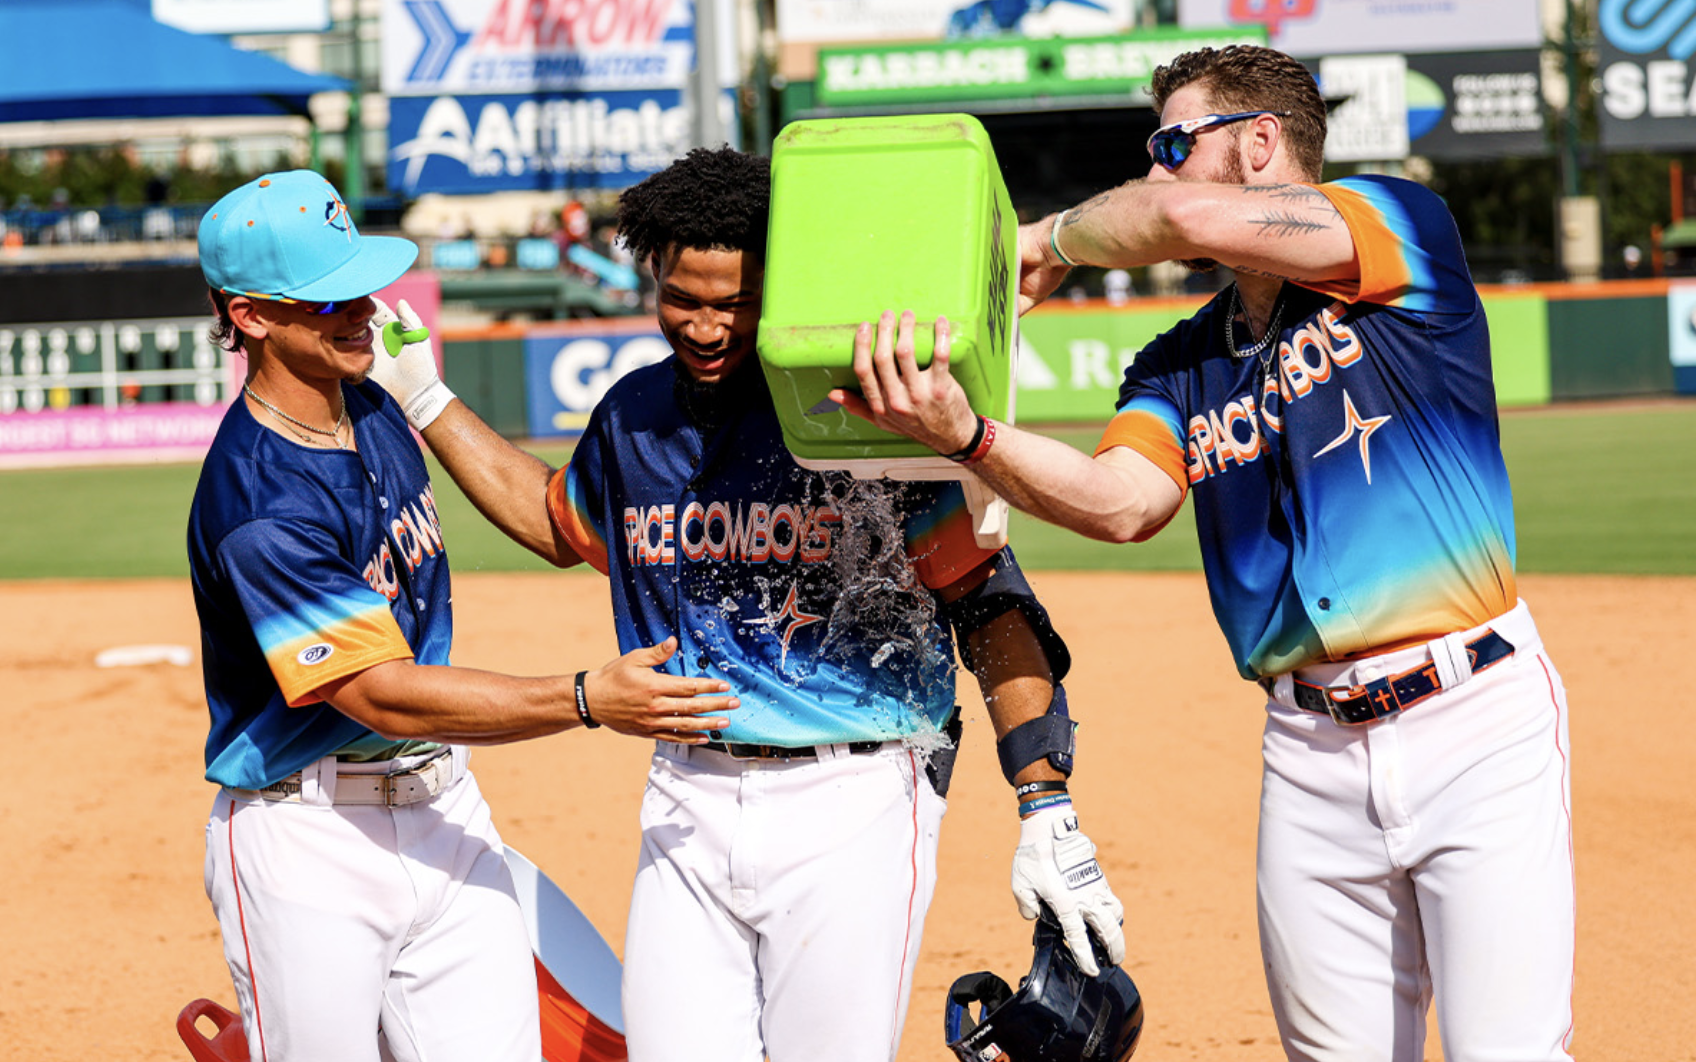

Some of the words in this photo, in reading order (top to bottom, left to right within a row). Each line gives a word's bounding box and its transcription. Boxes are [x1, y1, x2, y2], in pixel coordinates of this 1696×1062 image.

[471, 0, 679, 47] ARROW
[824, 49, 1029, 92] KARBACH
[1603, 60, 1696, 120] SE
[681, 500, 843, 565] COWBOYS
